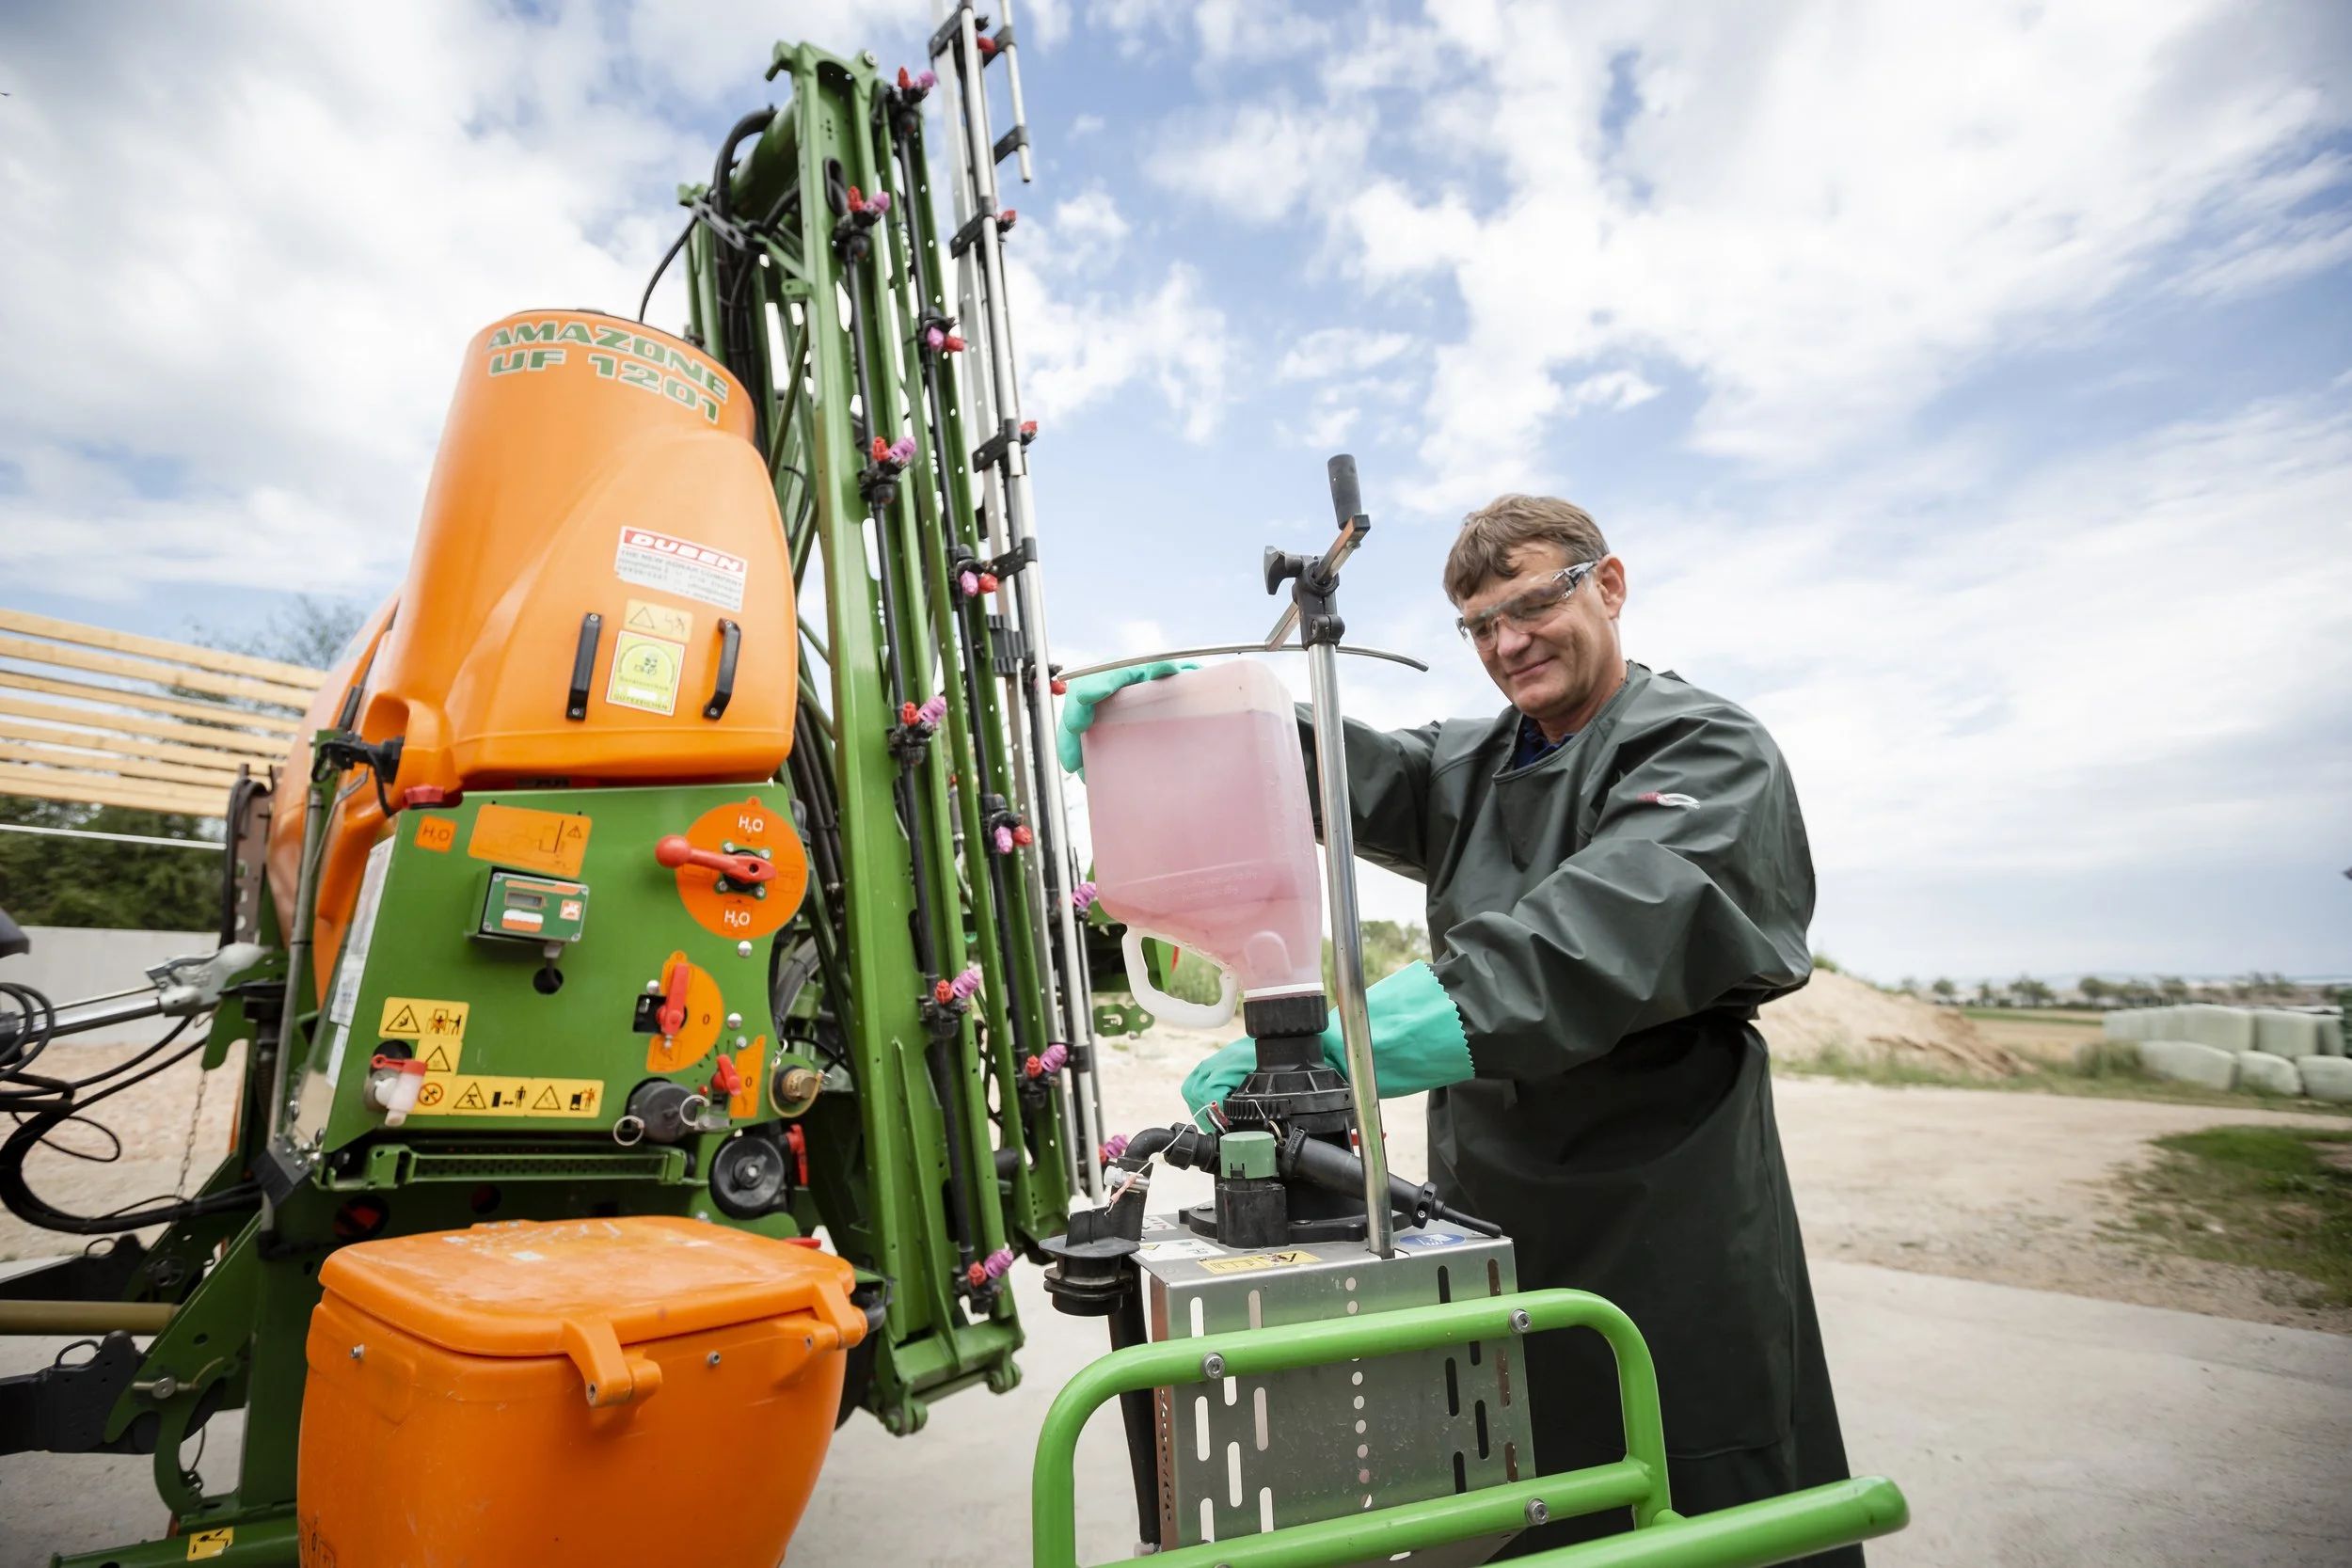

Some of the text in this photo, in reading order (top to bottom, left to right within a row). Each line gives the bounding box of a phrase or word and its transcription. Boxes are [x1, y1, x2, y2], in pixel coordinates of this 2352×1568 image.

[485, 321, 729, 404] AMAZONE
[488, 349, 719, 424] UF 1201
